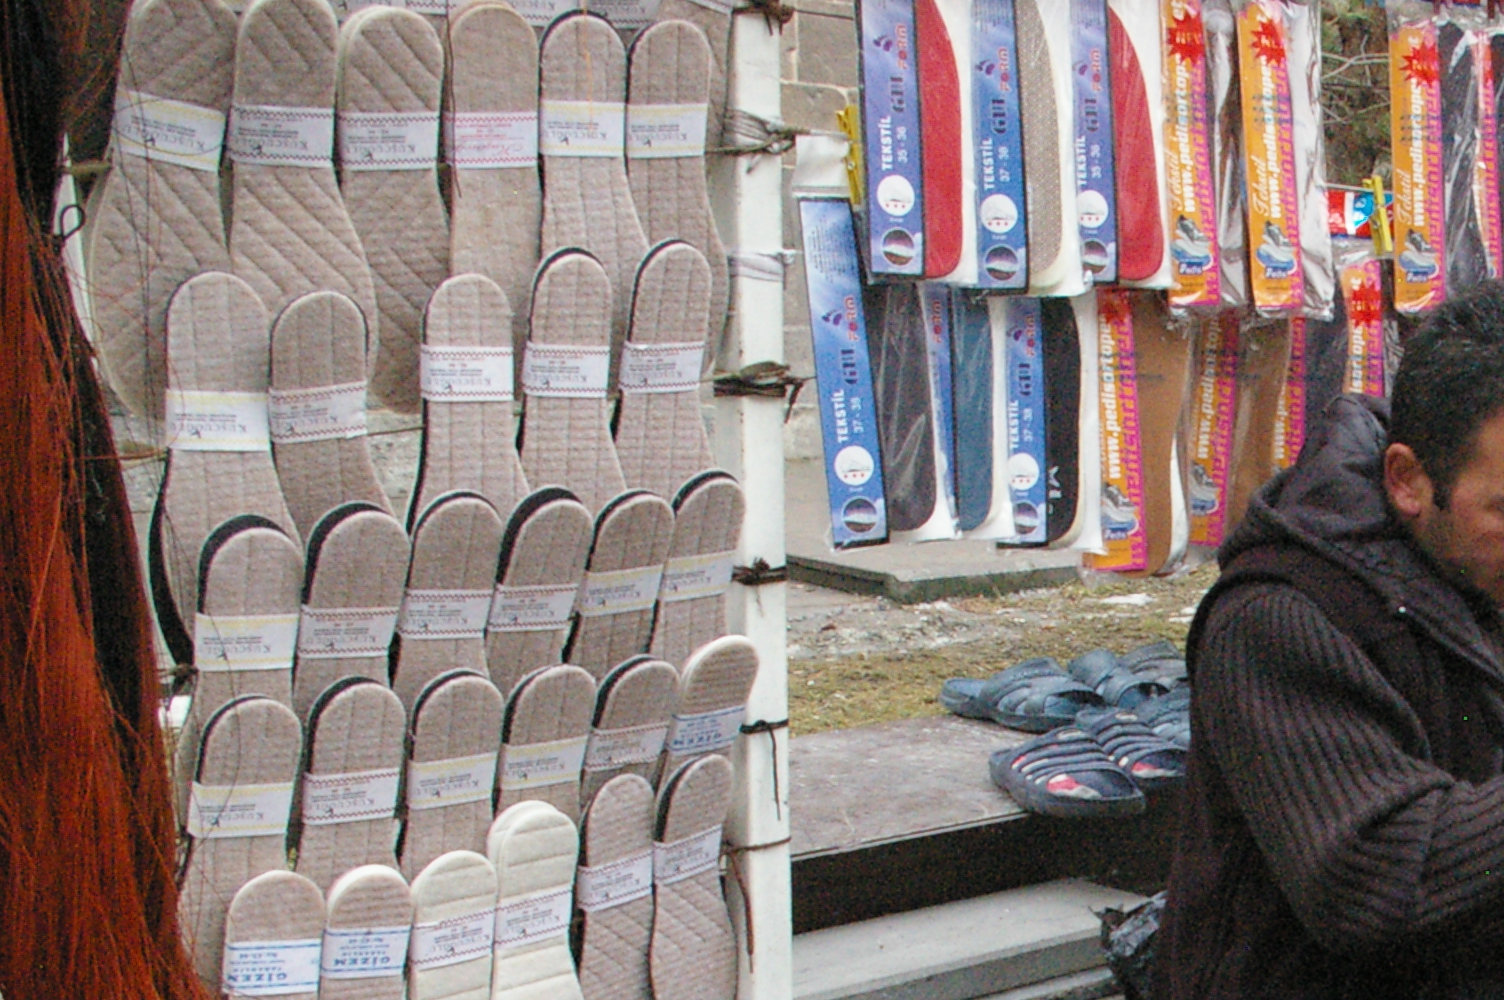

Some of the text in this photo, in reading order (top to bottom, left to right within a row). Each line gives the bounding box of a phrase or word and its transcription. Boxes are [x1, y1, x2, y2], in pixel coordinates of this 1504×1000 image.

[897, 25, 908, 69] FORM
[1000, 48, 1012, 91] FORM
[1091, 50, 1103, 91] FORM
[844, 296, 859, 341] FORM
[1023, 313, 1036, 356] FORM
